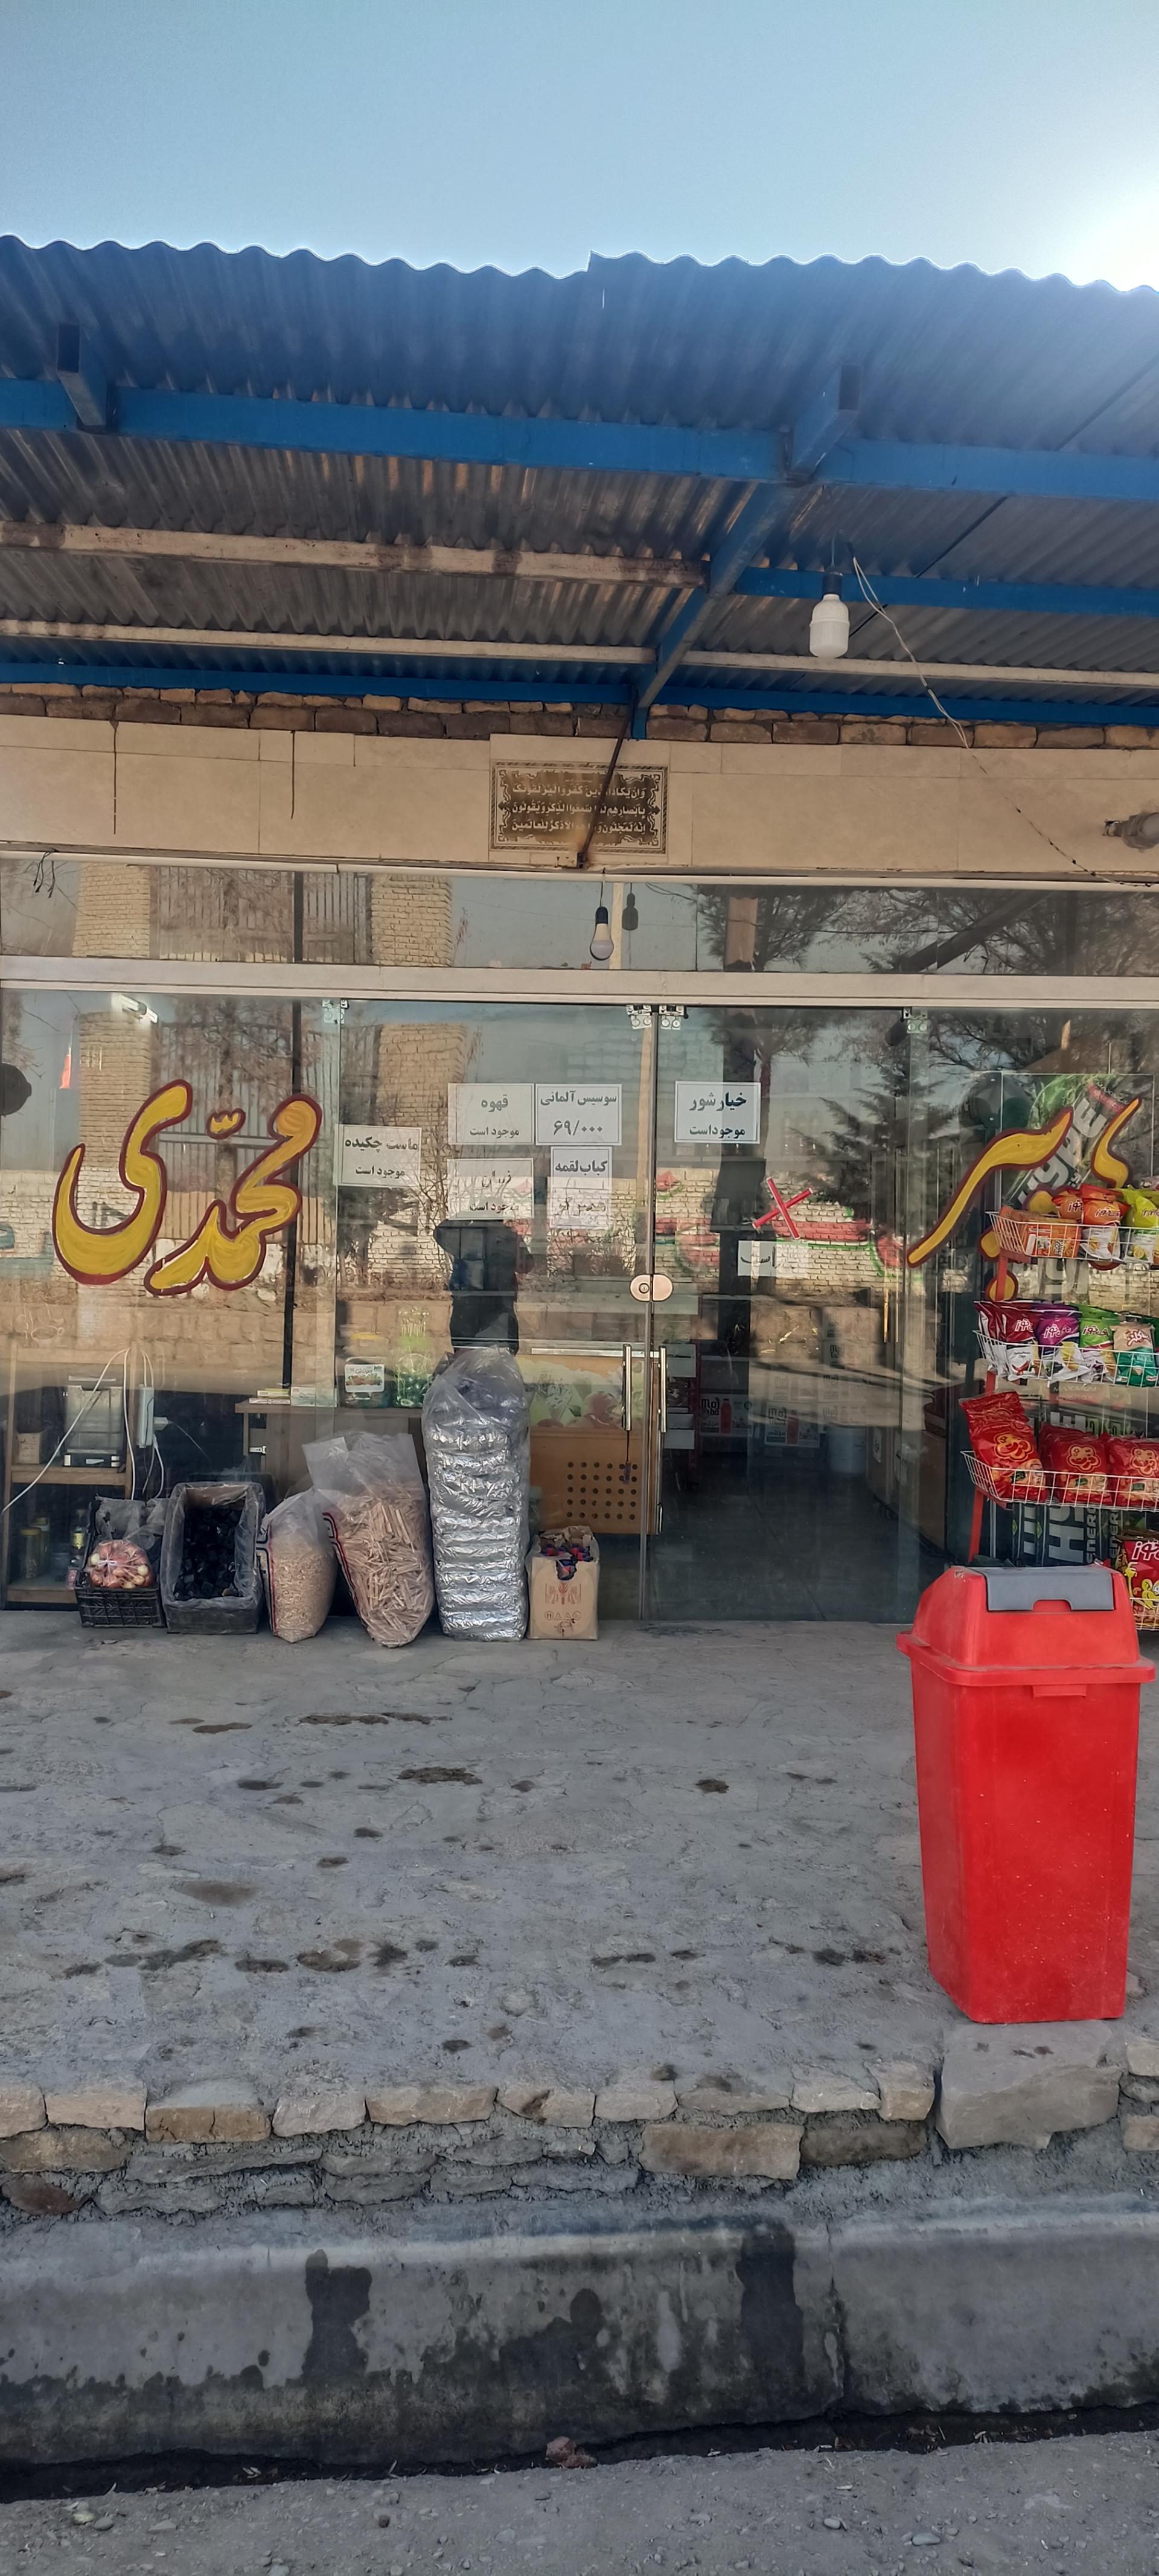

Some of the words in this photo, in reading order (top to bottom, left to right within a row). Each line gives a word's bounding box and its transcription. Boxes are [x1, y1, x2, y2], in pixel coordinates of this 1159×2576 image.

[481, 1094, 508, 1112] قهوه
[540, 1090, 576, 1106] آلمانی
[575, 1095, 617, 1106] سوسیس
[689, 1091, 716, 1111] شور
[717, 1091, 747, 1111] خیار
[469, 1126, 488, 1136] است
[488, 1129, 520, 1137] موجود
[689, 1125, 712, 1136] است
[712, 1128, 746, 1139] موجود
[344, 1136, 383, 1152] چکیده
[386, 1137, 418, 1151] ماست
[355, 1165, 375, 1175] است
[555, 1160, 579, 1172] لقمه
[580, 1160, 607, 1176] کباب
[375, 1169, 406, 1180] موجود
[469, 1201, 488, 1211] است
